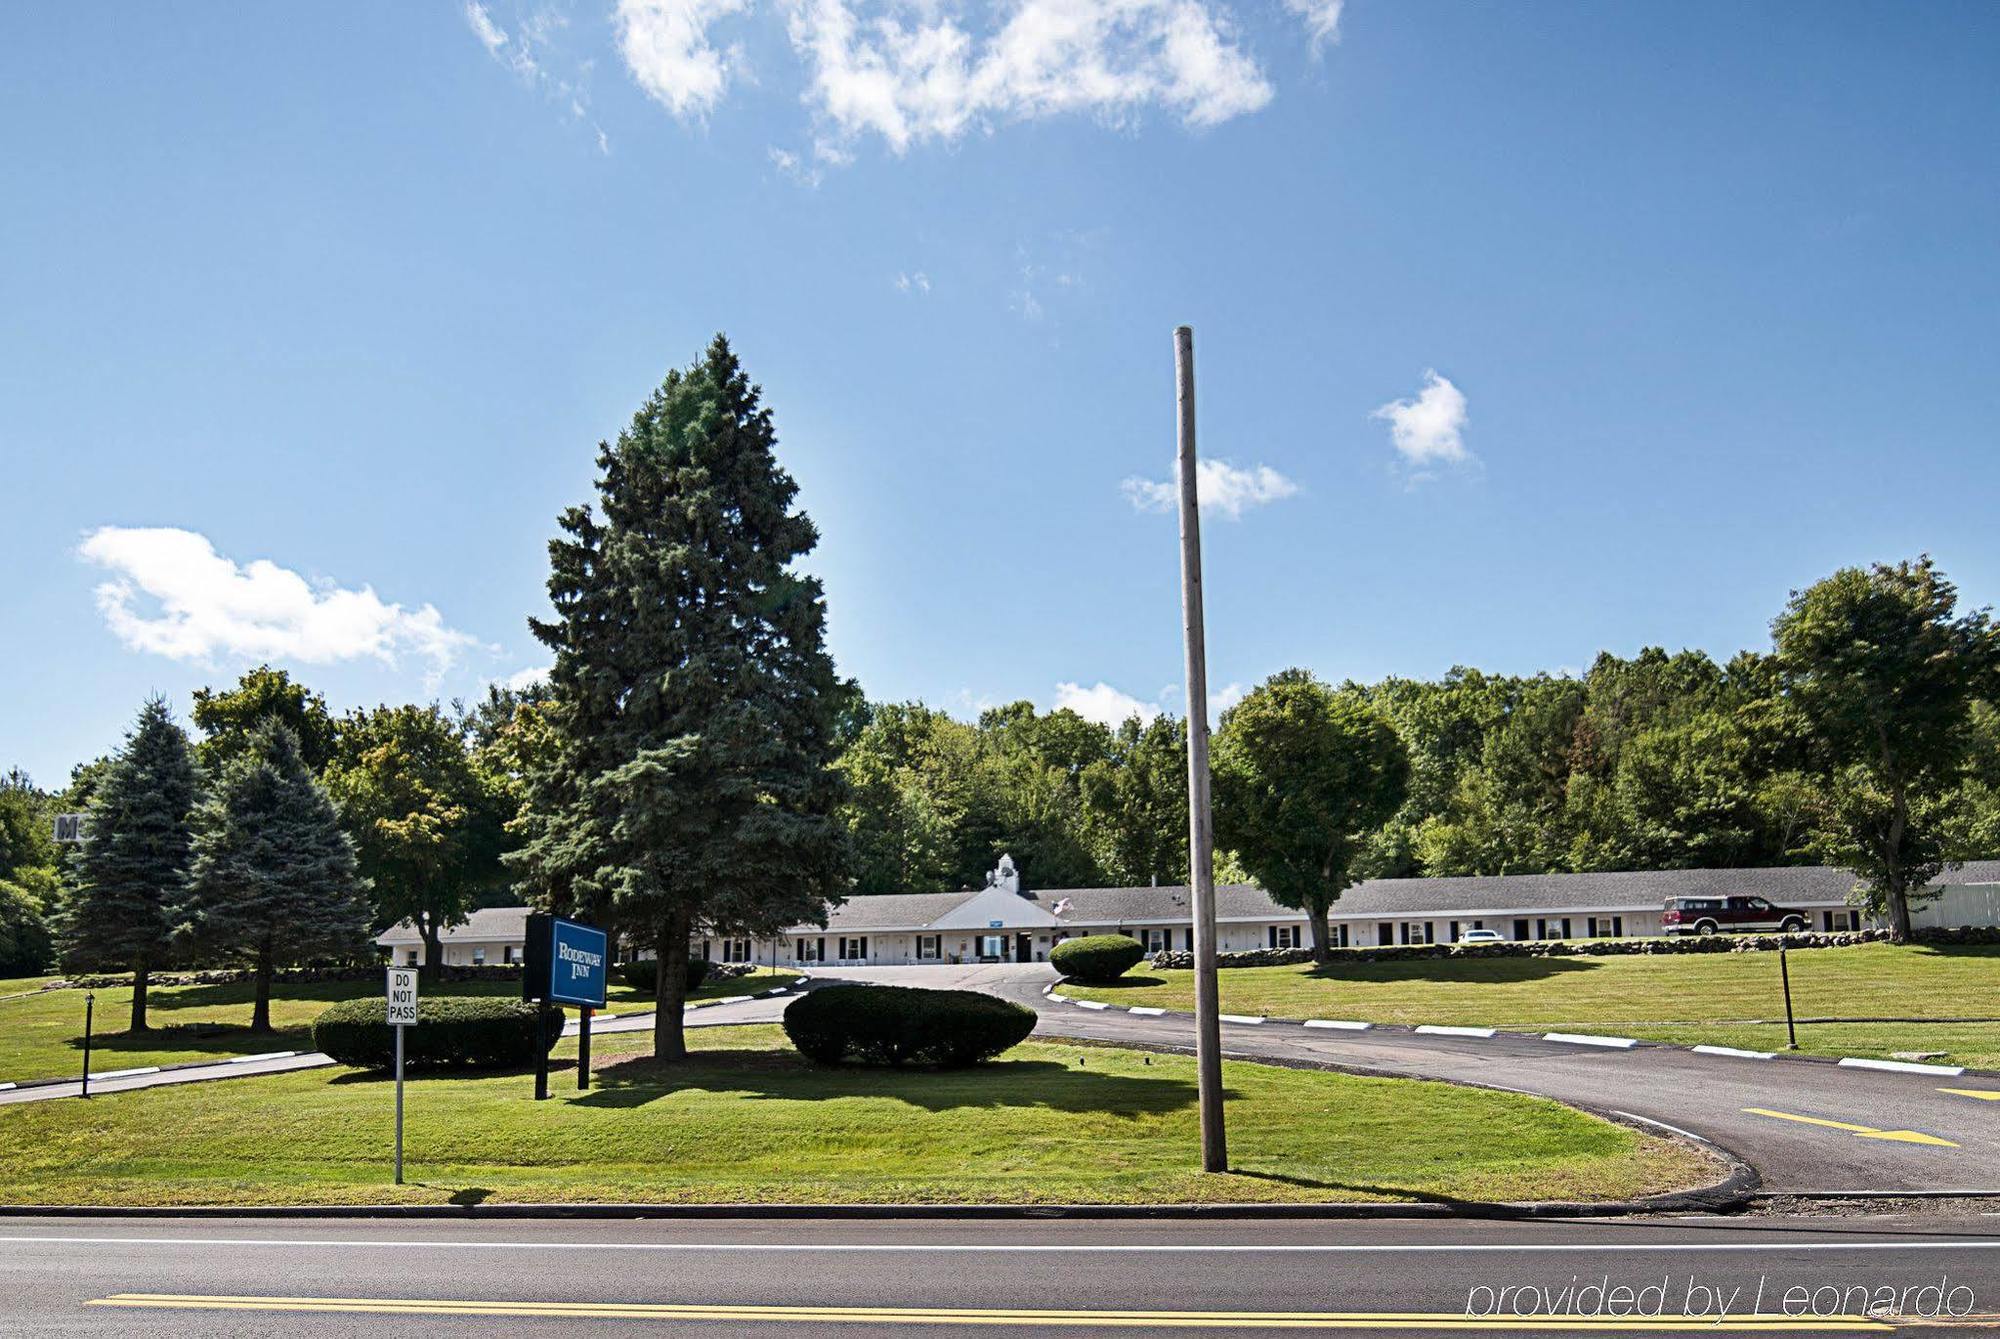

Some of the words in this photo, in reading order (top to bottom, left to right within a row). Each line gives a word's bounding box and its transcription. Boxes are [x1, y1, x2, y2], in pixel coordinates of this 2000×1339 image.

[559, 941, 602, 967] RODEWAY
[571, 963, 590, 979] INN
[396, 974, 410, 987] DO
[393, 990, 412, 1003] NOT
[390, 1006, 415, 1019] PASS
